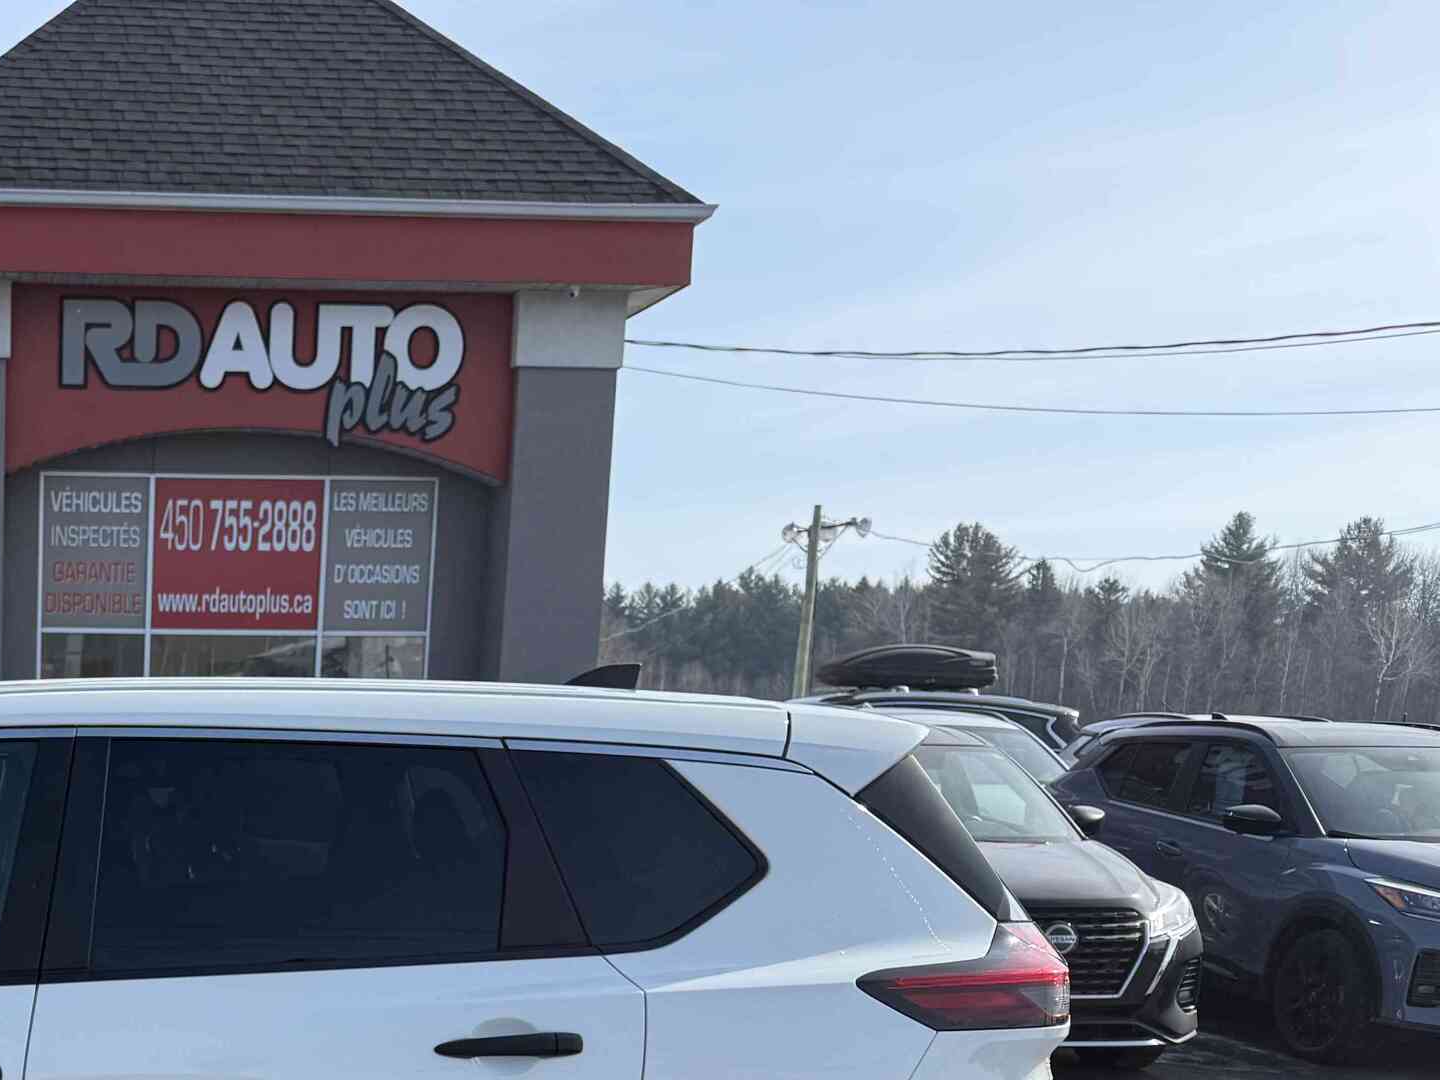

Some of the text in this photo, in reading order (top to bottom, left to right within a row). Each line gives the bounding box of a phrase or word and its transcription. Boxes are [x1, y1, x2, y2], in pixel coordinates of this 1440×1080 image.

[324, 350, 460, 447] plus
[50, 487, 143, 514] VÉHICULES
[334, 491, 429, 513] LES MEILLEURS
[50, 523, 141, 549] INSPECTÉS
[159, 498, 317, 552] 450 755-2888
[344, 521, 413, 549] VÉHICULES
[52, 560, 137, 584] GARANTIE
[44, 592, 143, 616] DISPONIBLE
[157, 586, 313, 621] www.rdautoplus.ca
[343, 600, 379, 620] SONT
[380, 600, 396, 620] ICI
